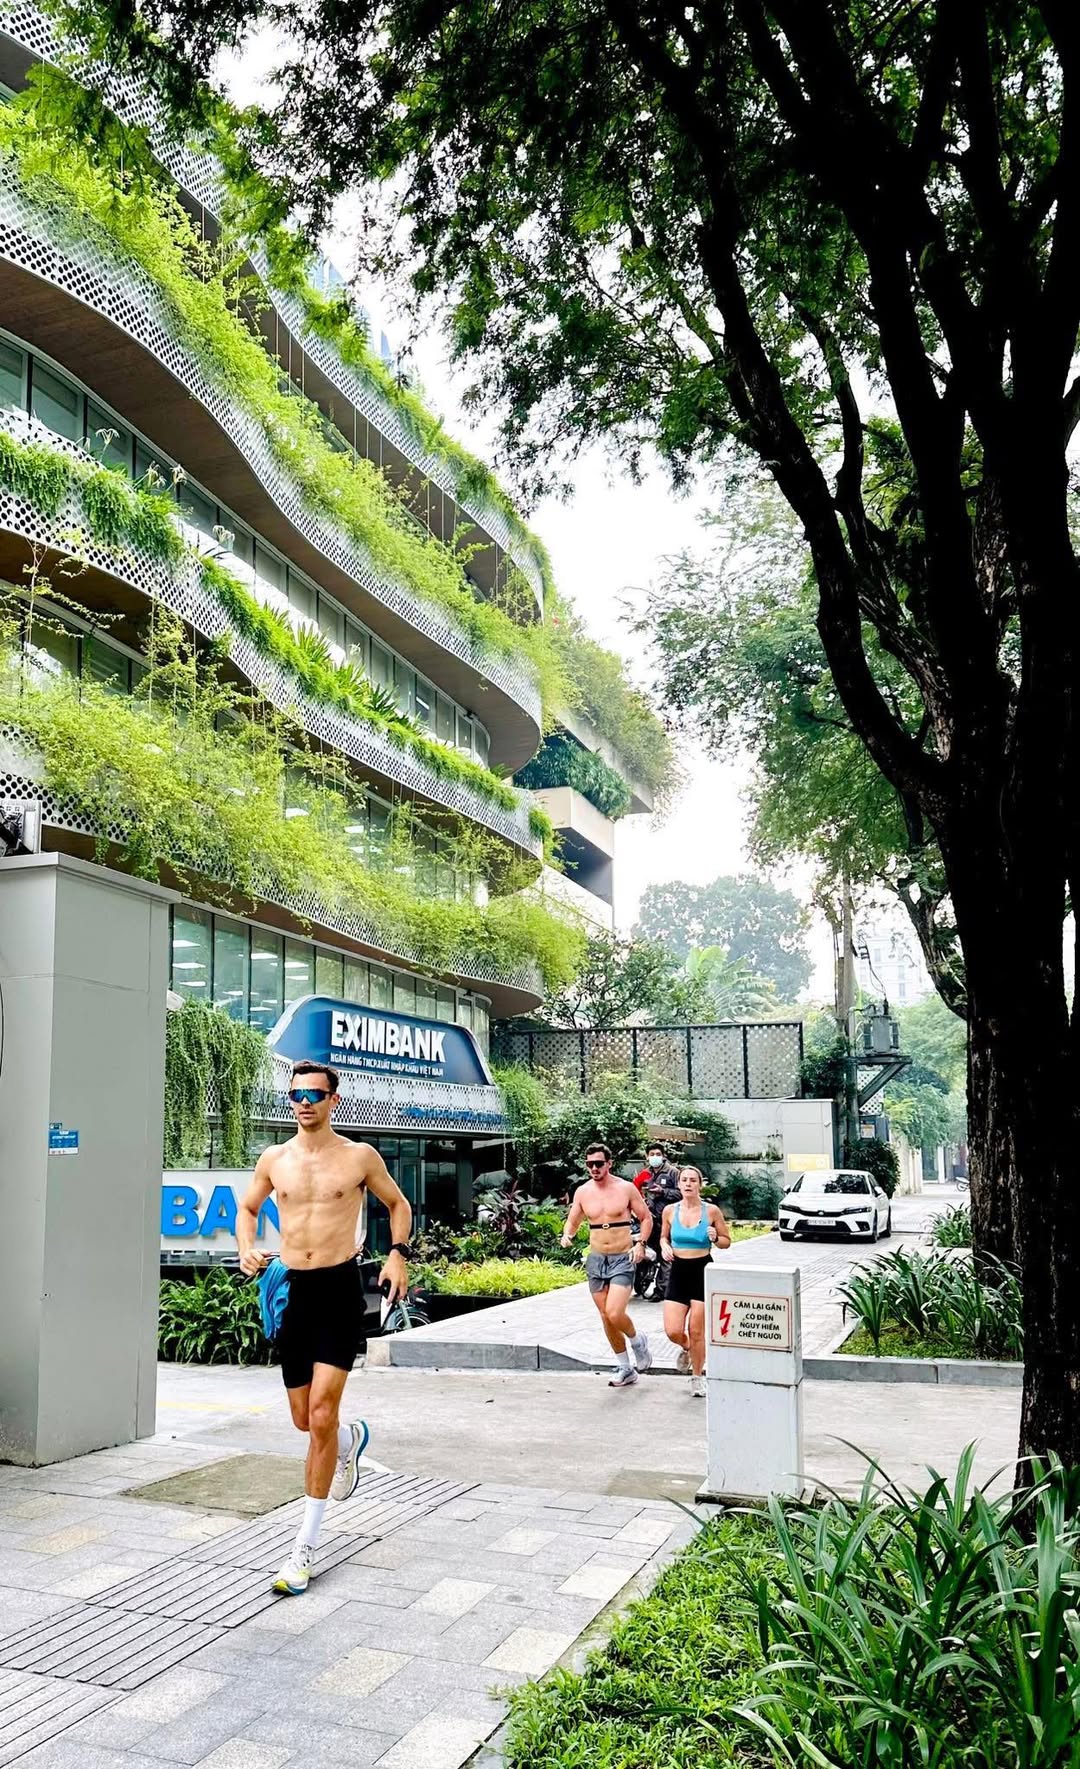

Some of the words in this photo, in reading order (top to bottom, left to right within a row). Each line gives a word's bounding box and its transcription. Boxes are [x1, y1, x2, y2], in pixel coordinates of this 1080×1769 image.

[331, 1010, 446, 1063] EXIMBANK
[330, 1052, 346, 1064] NGÂN
[431, 1066, 444, 1076] NAM
[740, 1321, 760, 1329] NGUY
